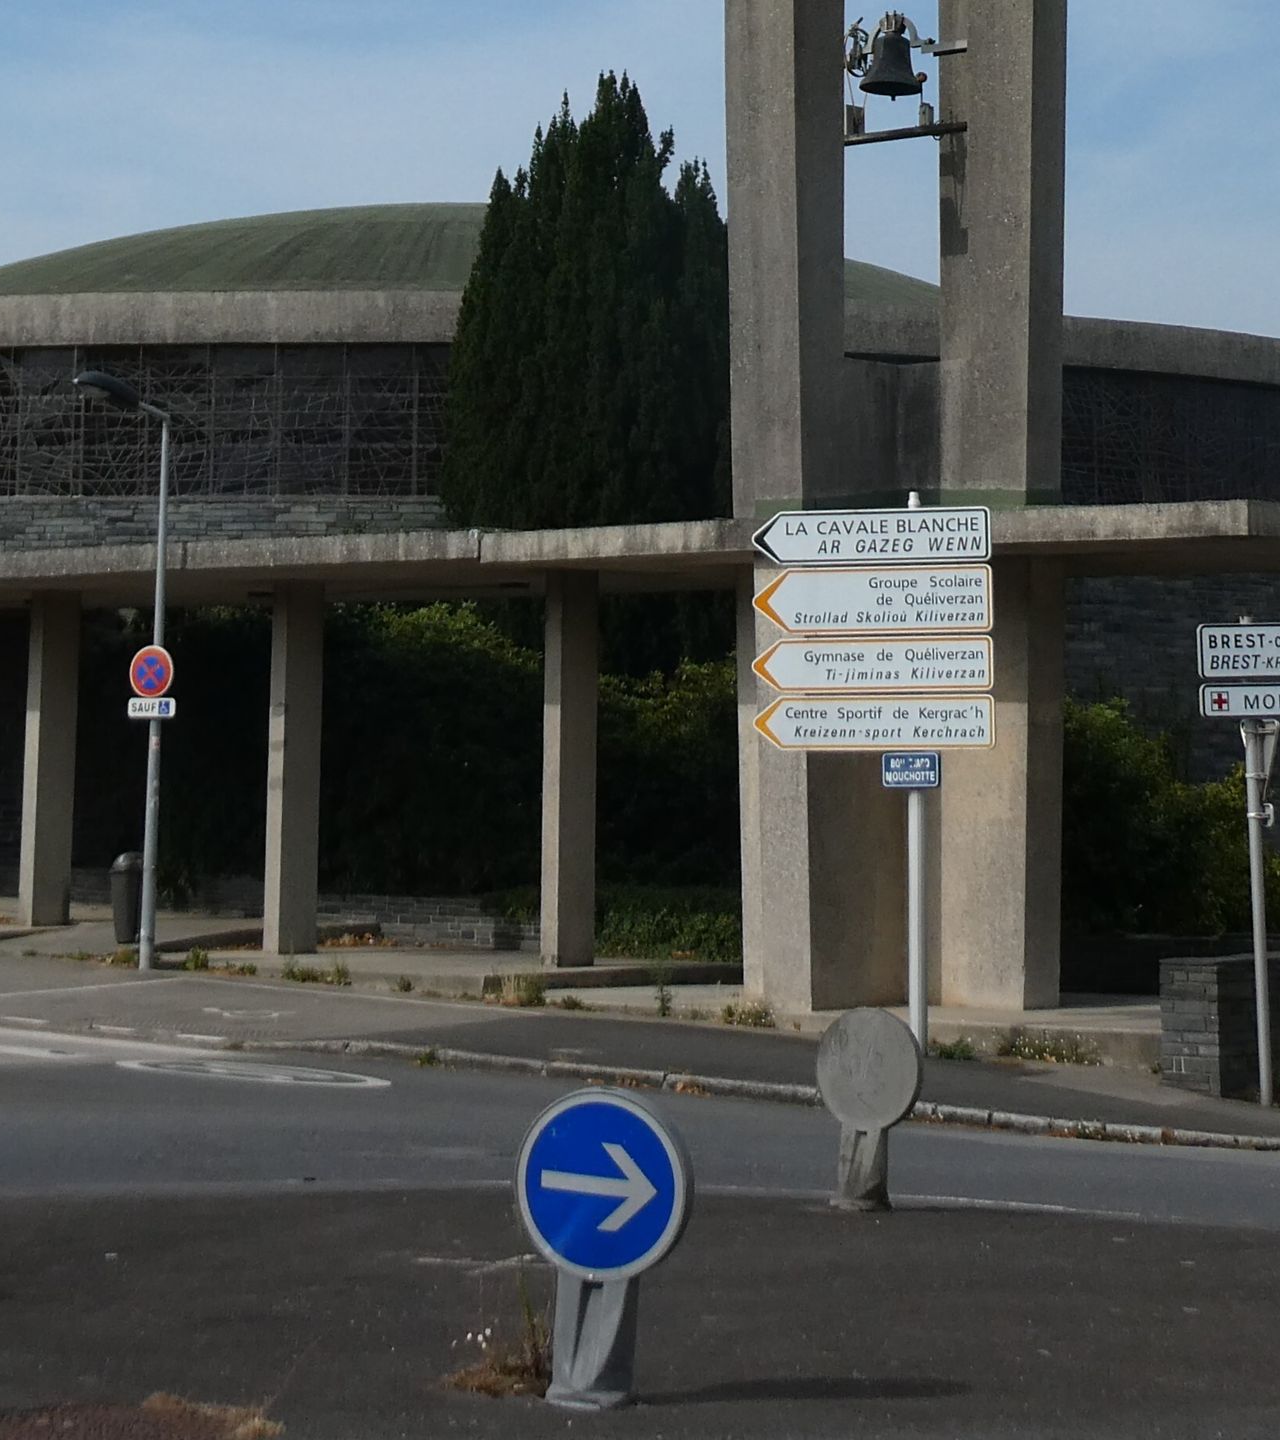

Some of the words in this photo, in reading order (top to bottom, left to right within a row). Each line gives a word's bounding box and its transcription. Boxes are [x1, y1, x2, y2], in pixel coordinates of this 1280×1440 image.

[785, 521, 808, 536] LA
[816, 519, 888, 535] CAVALE
[896, 517, 979, 534] BLANCHE
[817, 539, 841, 555] AR
[855, 538, 914, 553] GAZEG
[928, 536, 982, 551] WENN
[868, 577, 918, 593] Groupe
[929, 576, 982, 588] Scolaire
[876, 593, 893, 606] de
[904, 592, 983, 606] Quéliverzan
[794, 612, 848, 624] Strollad
[915, 610, 984, 622] Kiliverzan
[804, 650, 865, 665] Gymnase
[876, 648, 893, 661] de
[904, 647, 984, 662] Quéliverzan
[826, 668, 900, 683] Ti-jiminas
[910, 666, 985, 679] Kiliverzan
[131, 702, 156, 712] SAUF
[785, 707, 828, 720] Centre
[837, 706, 883, 723] Sportif
[892, 706, 909, 719] de
[885, 771, 935, 782] MOUCHOTTE
